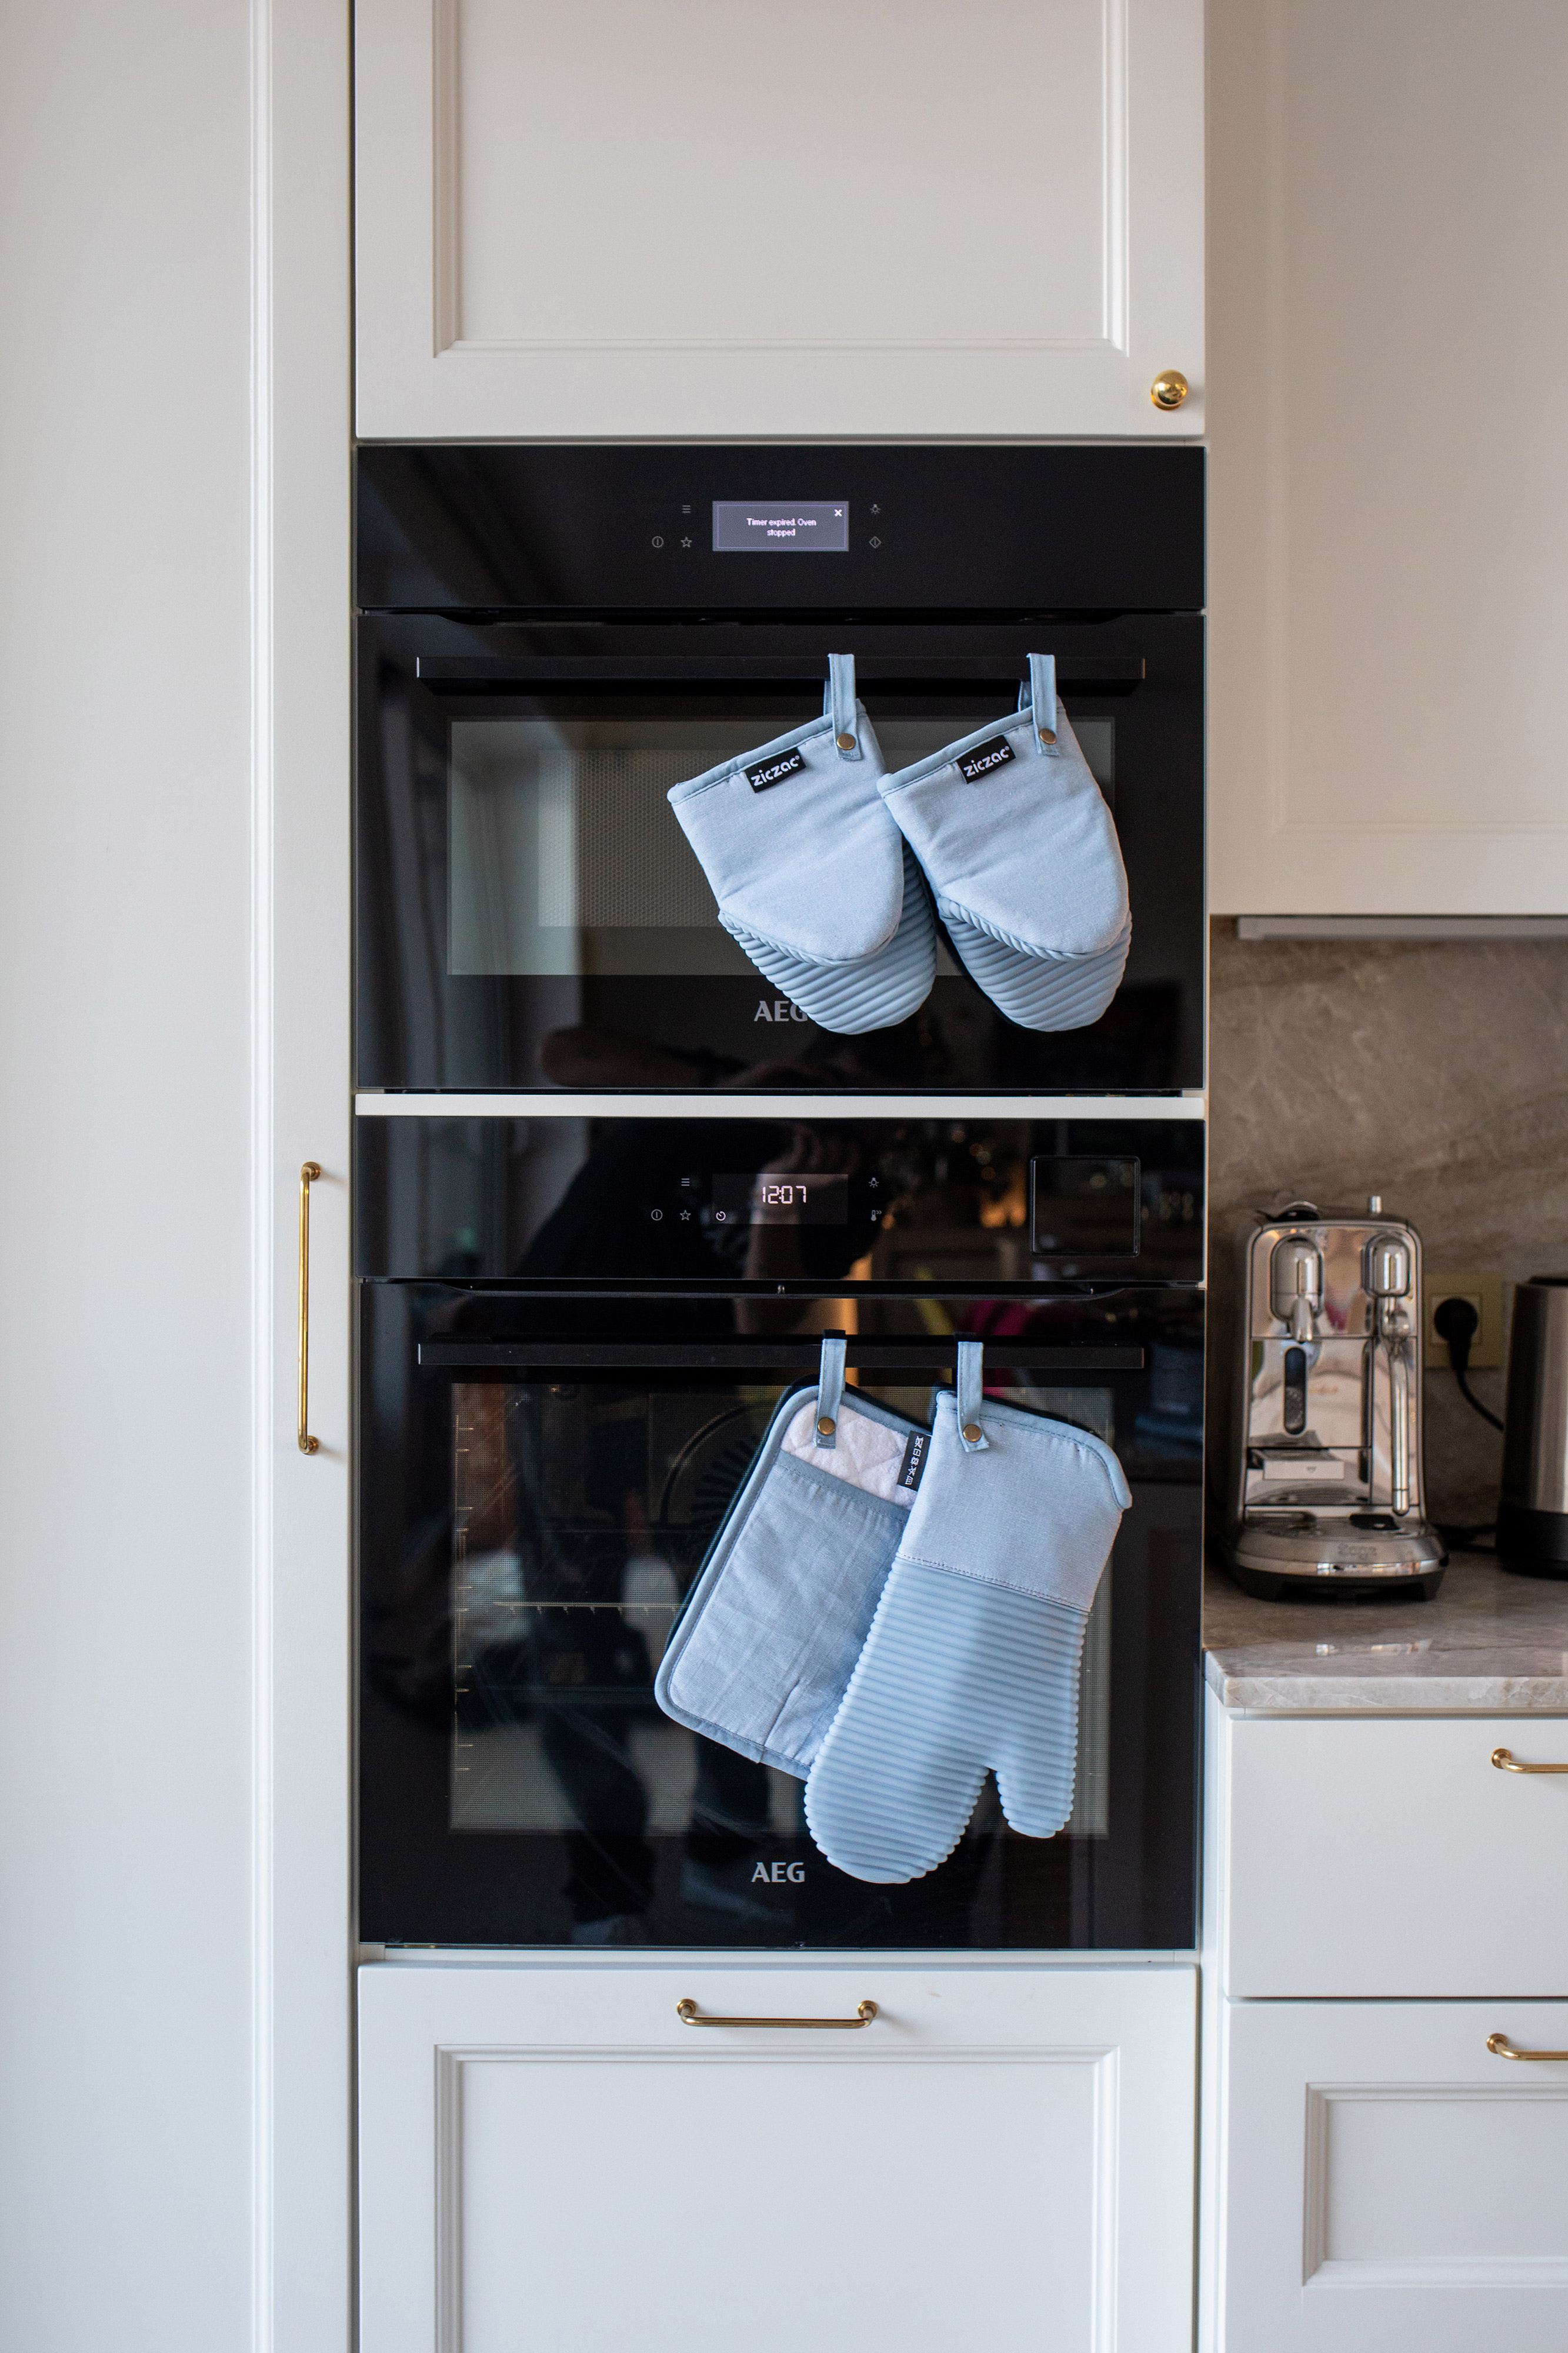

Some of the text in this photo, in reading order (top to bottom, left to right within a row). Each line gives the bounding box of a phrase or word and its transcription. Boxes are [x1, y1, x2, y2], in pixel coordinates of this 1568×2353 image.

[746, 518, 817, 527] Timer expired. Oven
[766, 528, 796, 537] stopped
[762, 1185, 806, 1204] 12:07
[751, 1862, 805, 1883] AEG
